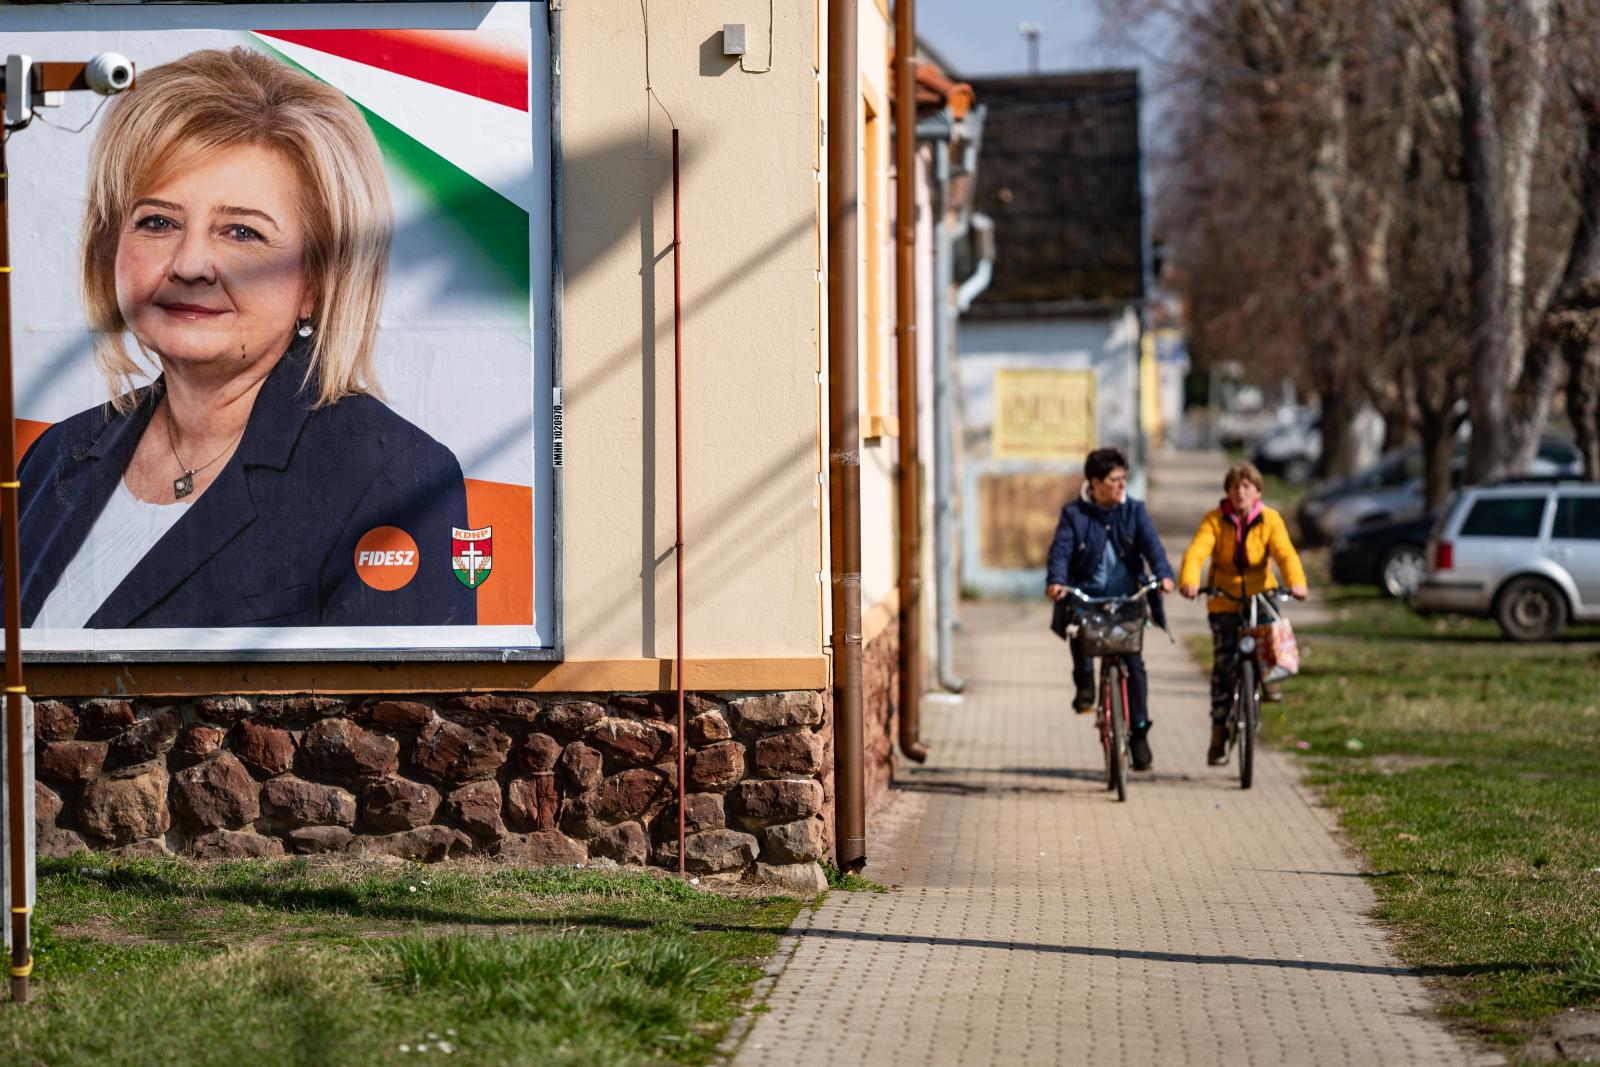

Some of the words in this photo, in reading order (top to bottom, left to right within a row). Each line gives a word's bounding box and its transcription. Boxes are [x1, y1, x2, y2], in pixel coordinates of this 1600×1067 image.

[553, 405, 563, 440] 1020970
[553, 442, 563, 466] NMHH
[454, 529, 489, 539] KDNP
[358, 550, 415, 567] FIDESZ
